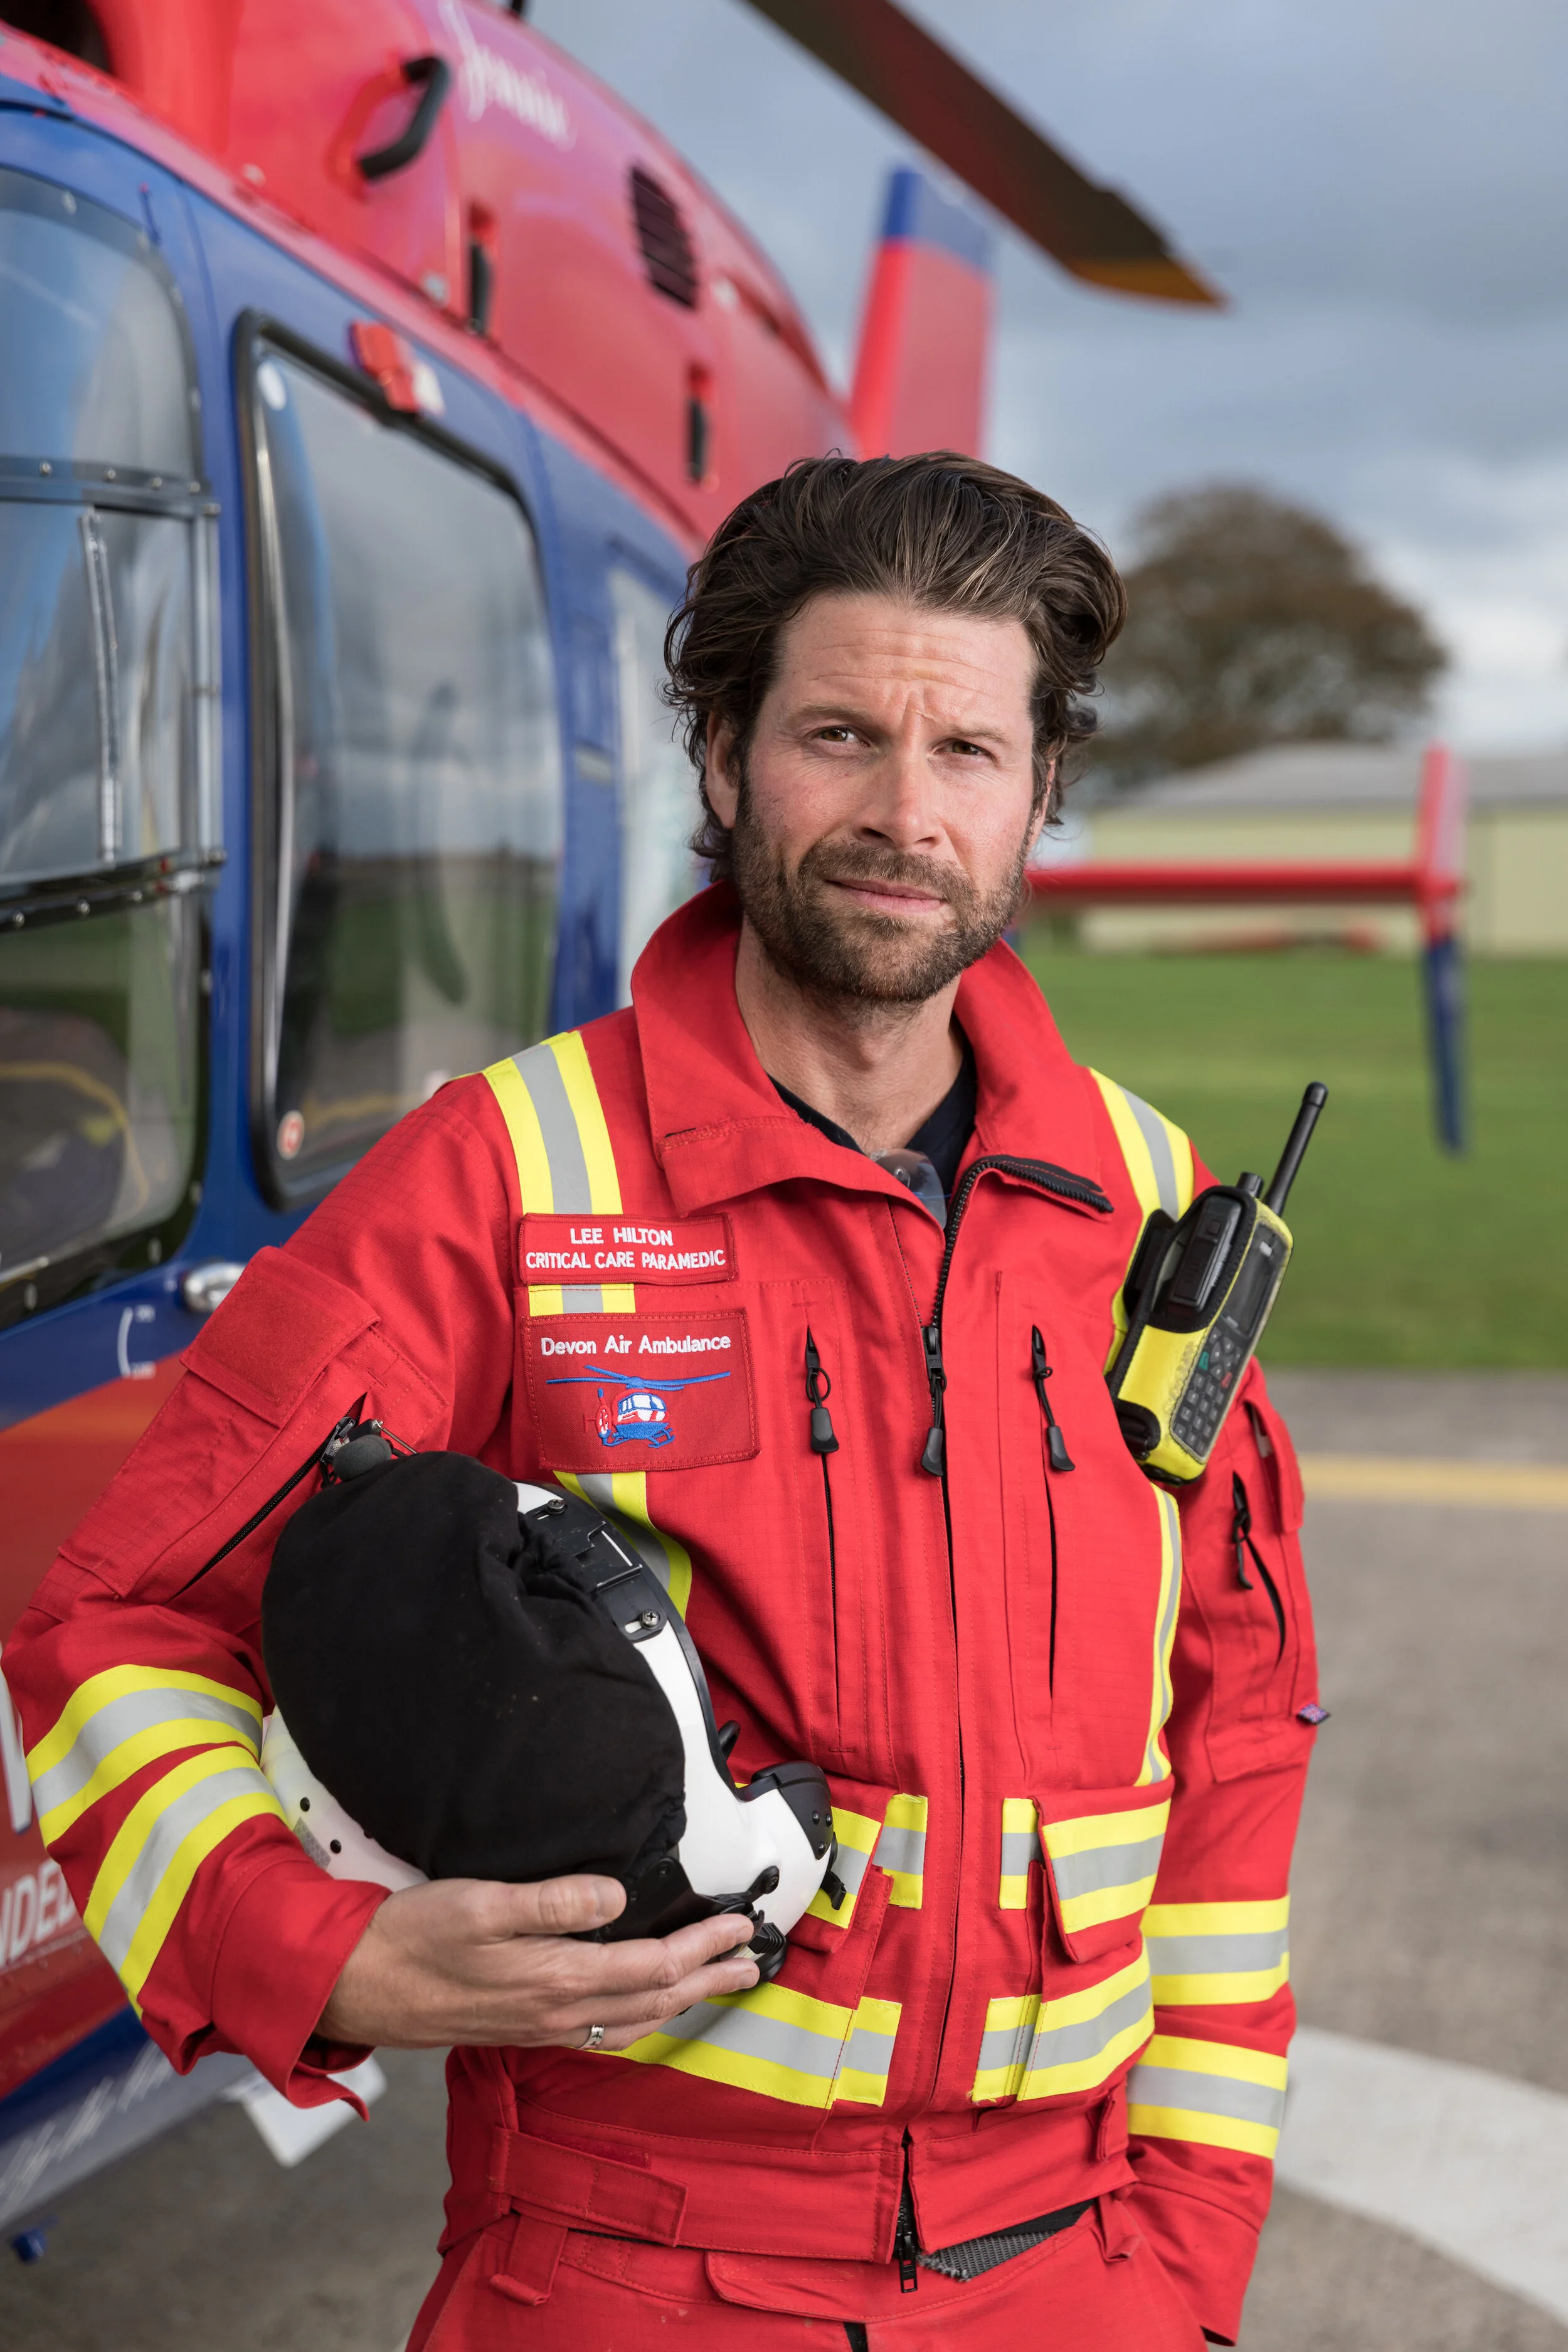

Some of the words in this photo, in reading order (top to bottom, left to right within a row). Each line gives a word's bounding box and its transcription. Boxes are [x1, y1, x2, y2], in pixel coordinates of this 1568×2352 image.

[570, 1227, 604, 1245] LEE
[613, 1227, 674, 1246] HILTON
[526, 1252, 591, 1269] CRITICAL
[594, 1251, 635, 1268] CARE
[642, 1249, 726, 1271] PARAMEDIC
[541, 1337, 597, 1356] Devon
[603, 1334, 633, 1353] Air
[638, 1335, 731, 1354] Ambulance
